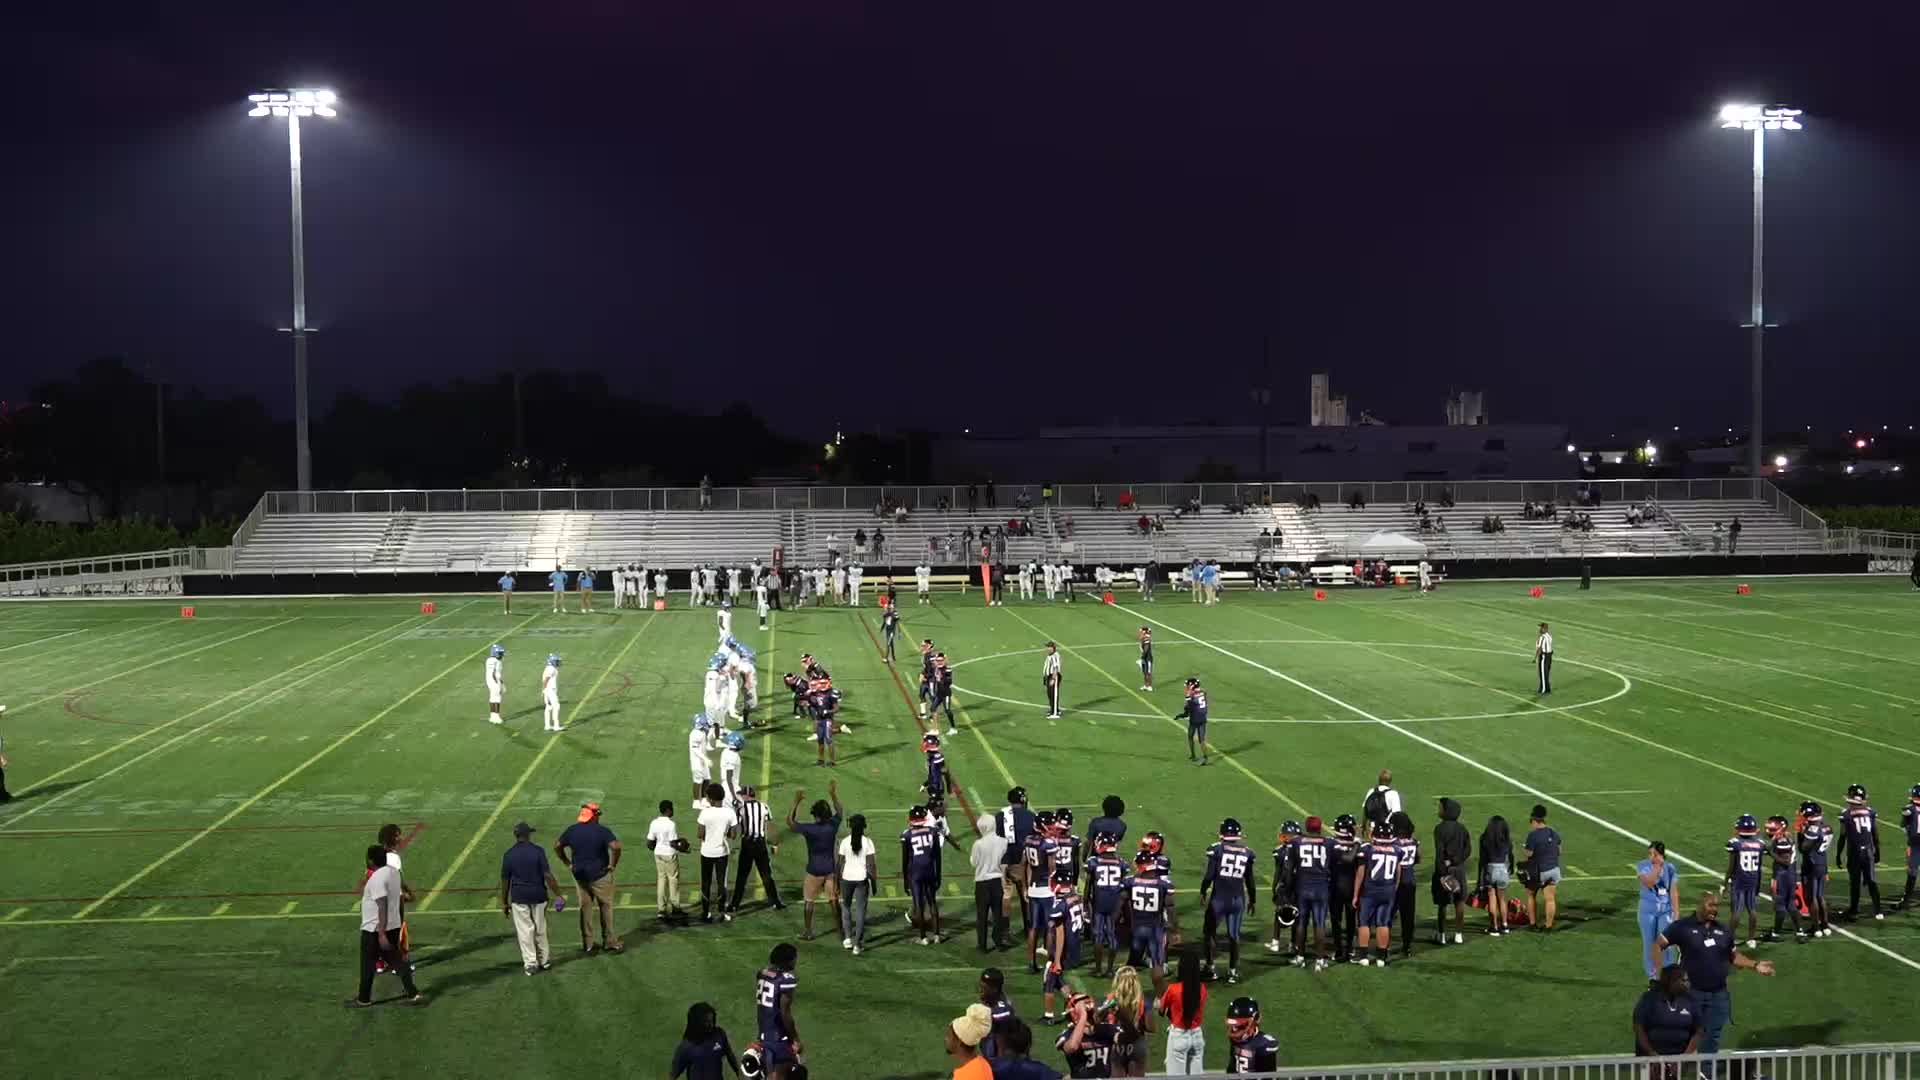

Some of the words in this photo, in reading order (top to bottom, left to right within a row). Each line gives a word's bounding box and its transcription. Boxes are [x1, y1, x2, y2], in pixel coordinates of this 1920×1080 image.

[1853, 817, 1871, 833] 14
[911, 834, 933, 855] 24
[1220, 853, 1248, 878] 55
[1300, 845, 1327, 868] 54
[1371, 854, 1398, 879] 70
[1096, 866, 1121, 886] 32
[1132, 886, 1159, 912] 53
[1084, 1047, 1109, 1068] 34
